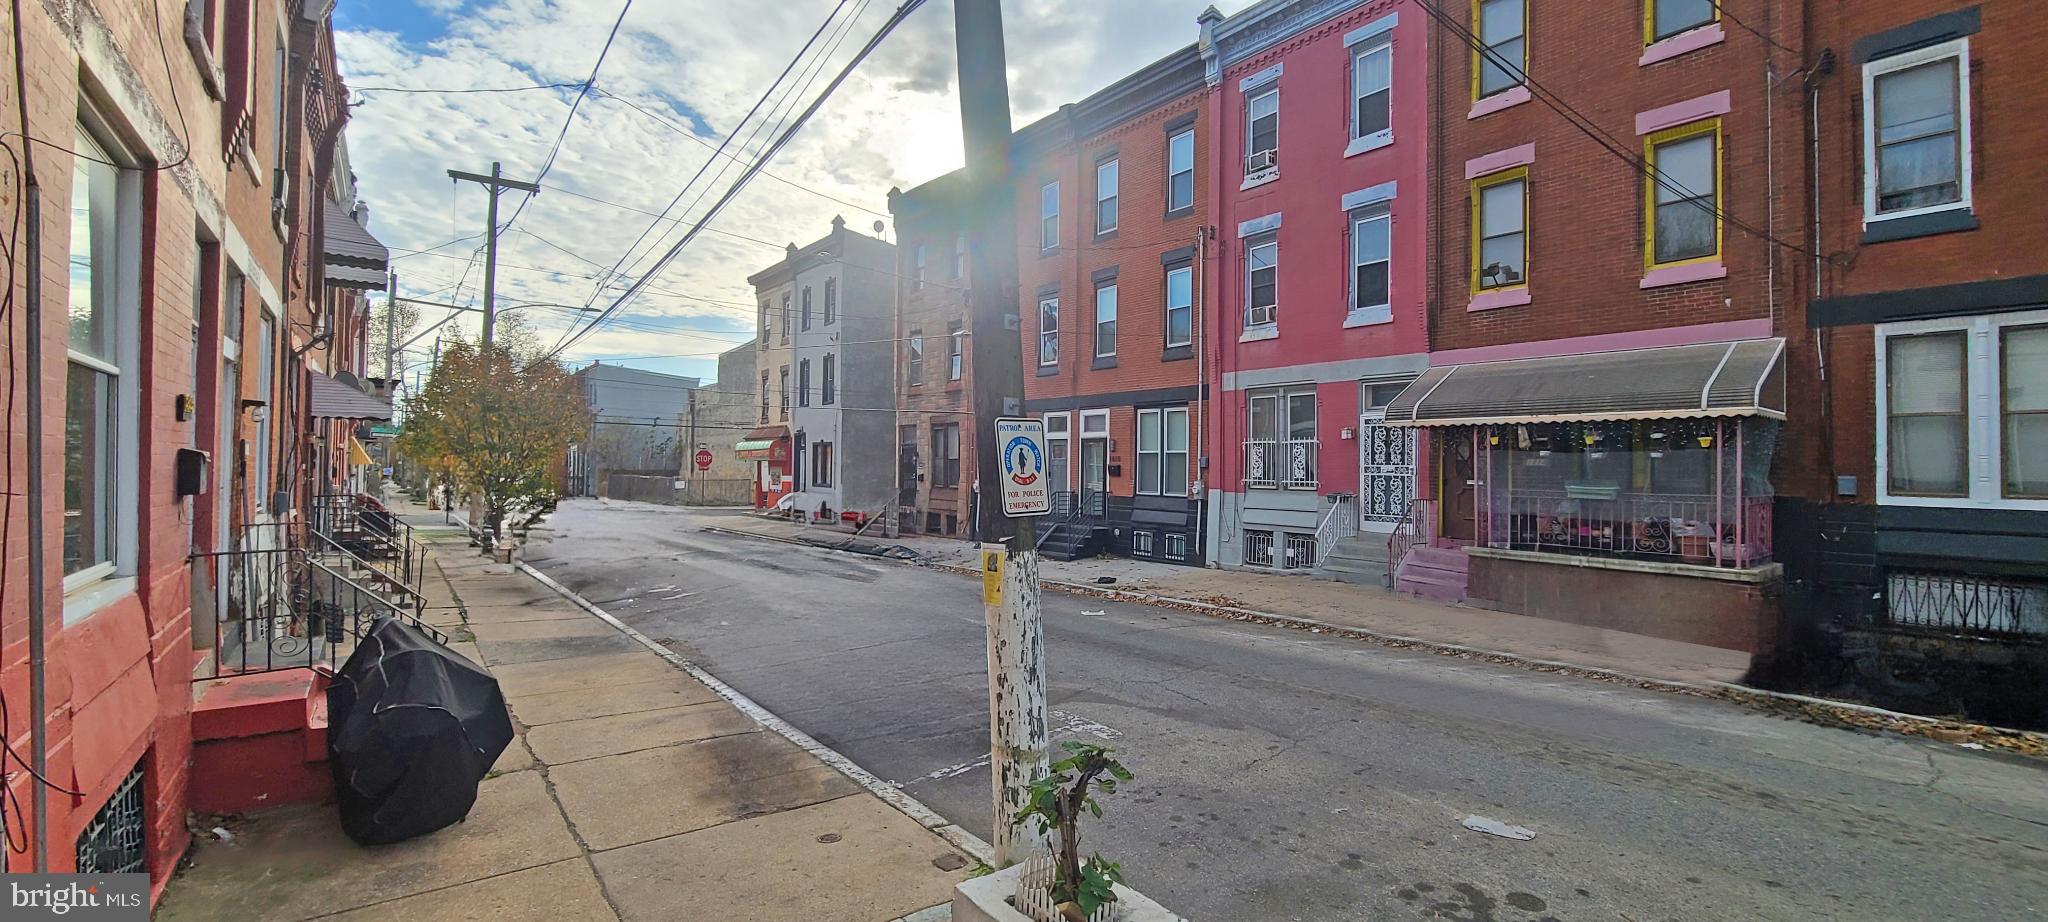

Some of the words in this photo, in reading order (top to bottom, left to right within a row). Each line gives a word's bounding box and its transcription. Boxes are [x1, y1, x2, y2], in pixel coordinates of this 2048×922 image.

[1000, 424, 1022, 432] PATROL
[1025, 424, 1041, 432] AREA
[1005, 440, 1016, 468] OPERATION
[1020, 437, 1032, 446] TOWN
[696, 455, 712, 463] STOP
[1009, 501, 1044, 509] EMERGENCY
